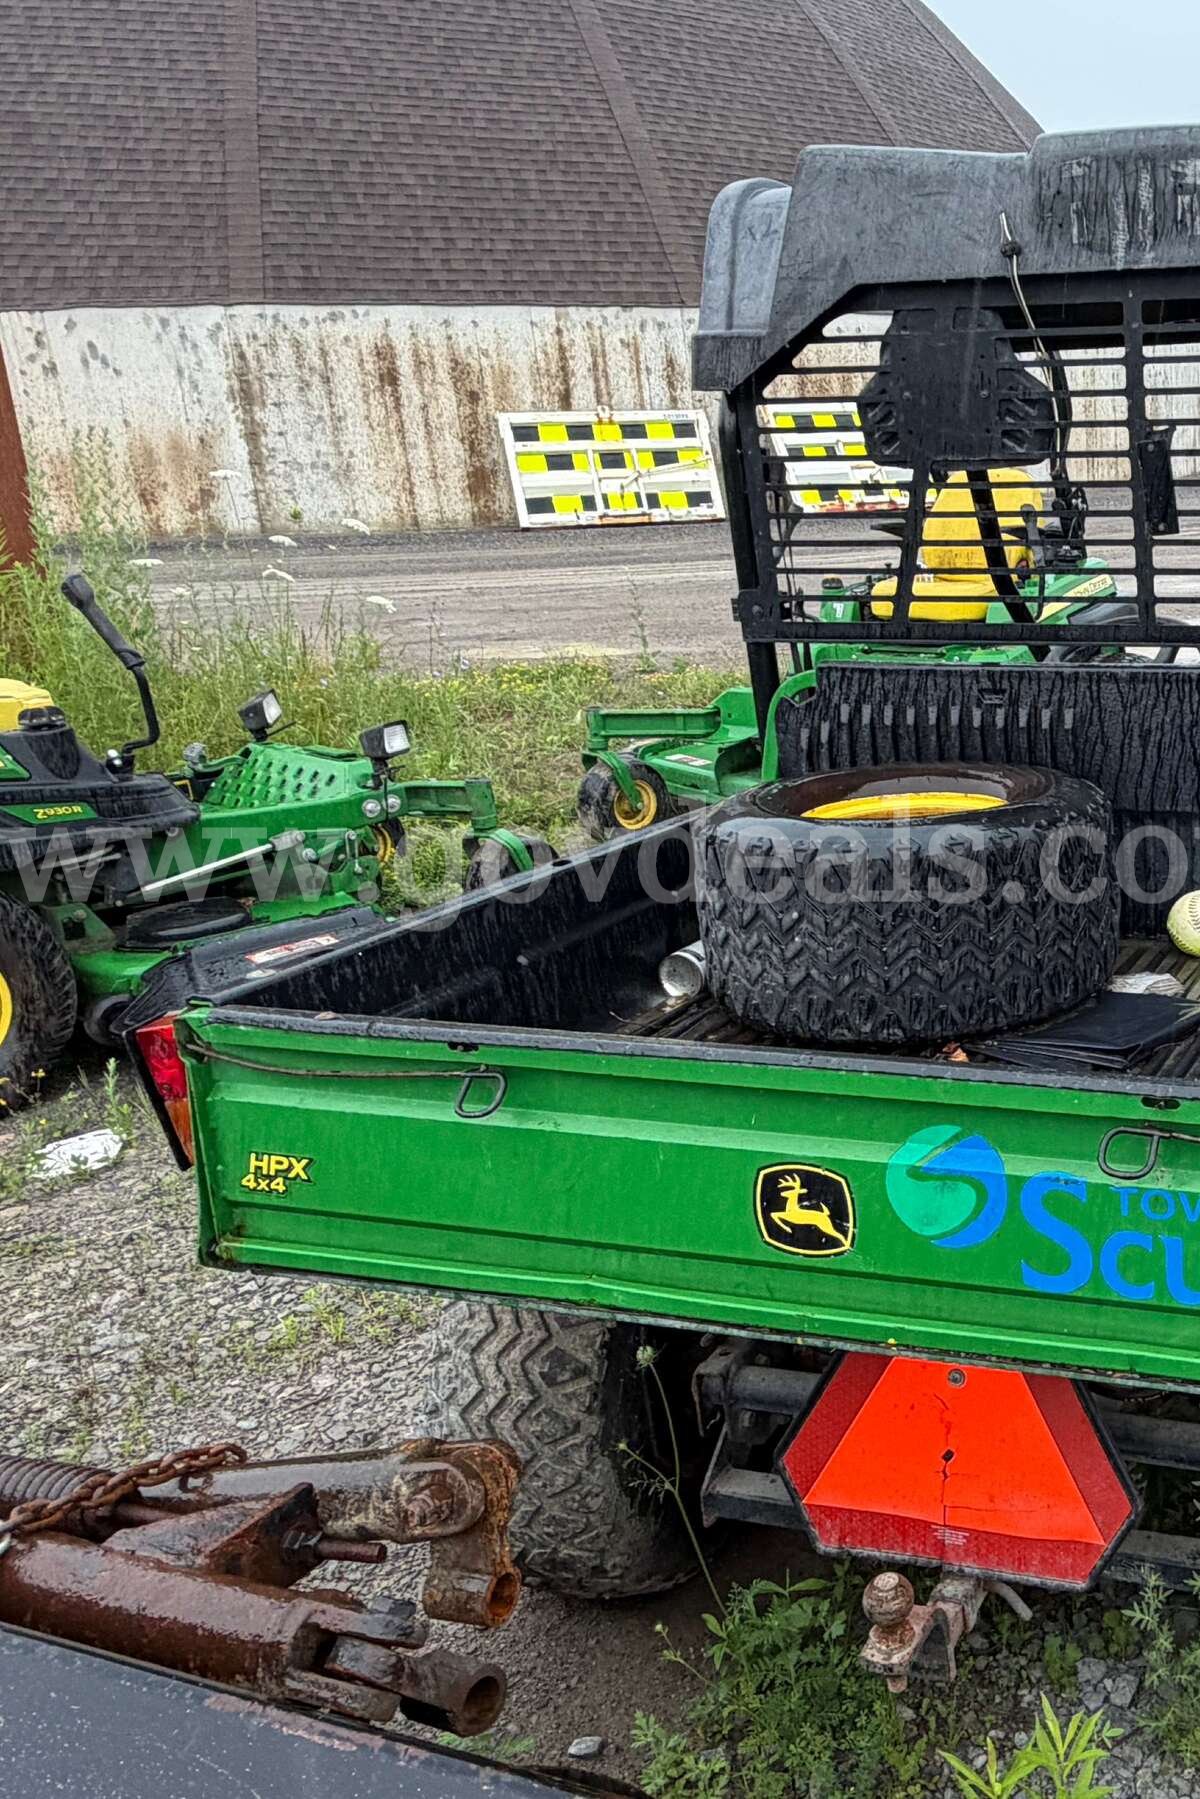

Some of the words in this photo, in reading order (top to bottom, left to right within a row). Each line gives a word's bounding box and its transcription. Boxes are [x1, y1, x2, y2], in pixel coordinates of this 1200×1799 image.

[33, 805, 83, 819] Z930R
[249, 1152, 310, 1180] HPX
[241, 1173, 286, 1193] 4x4
